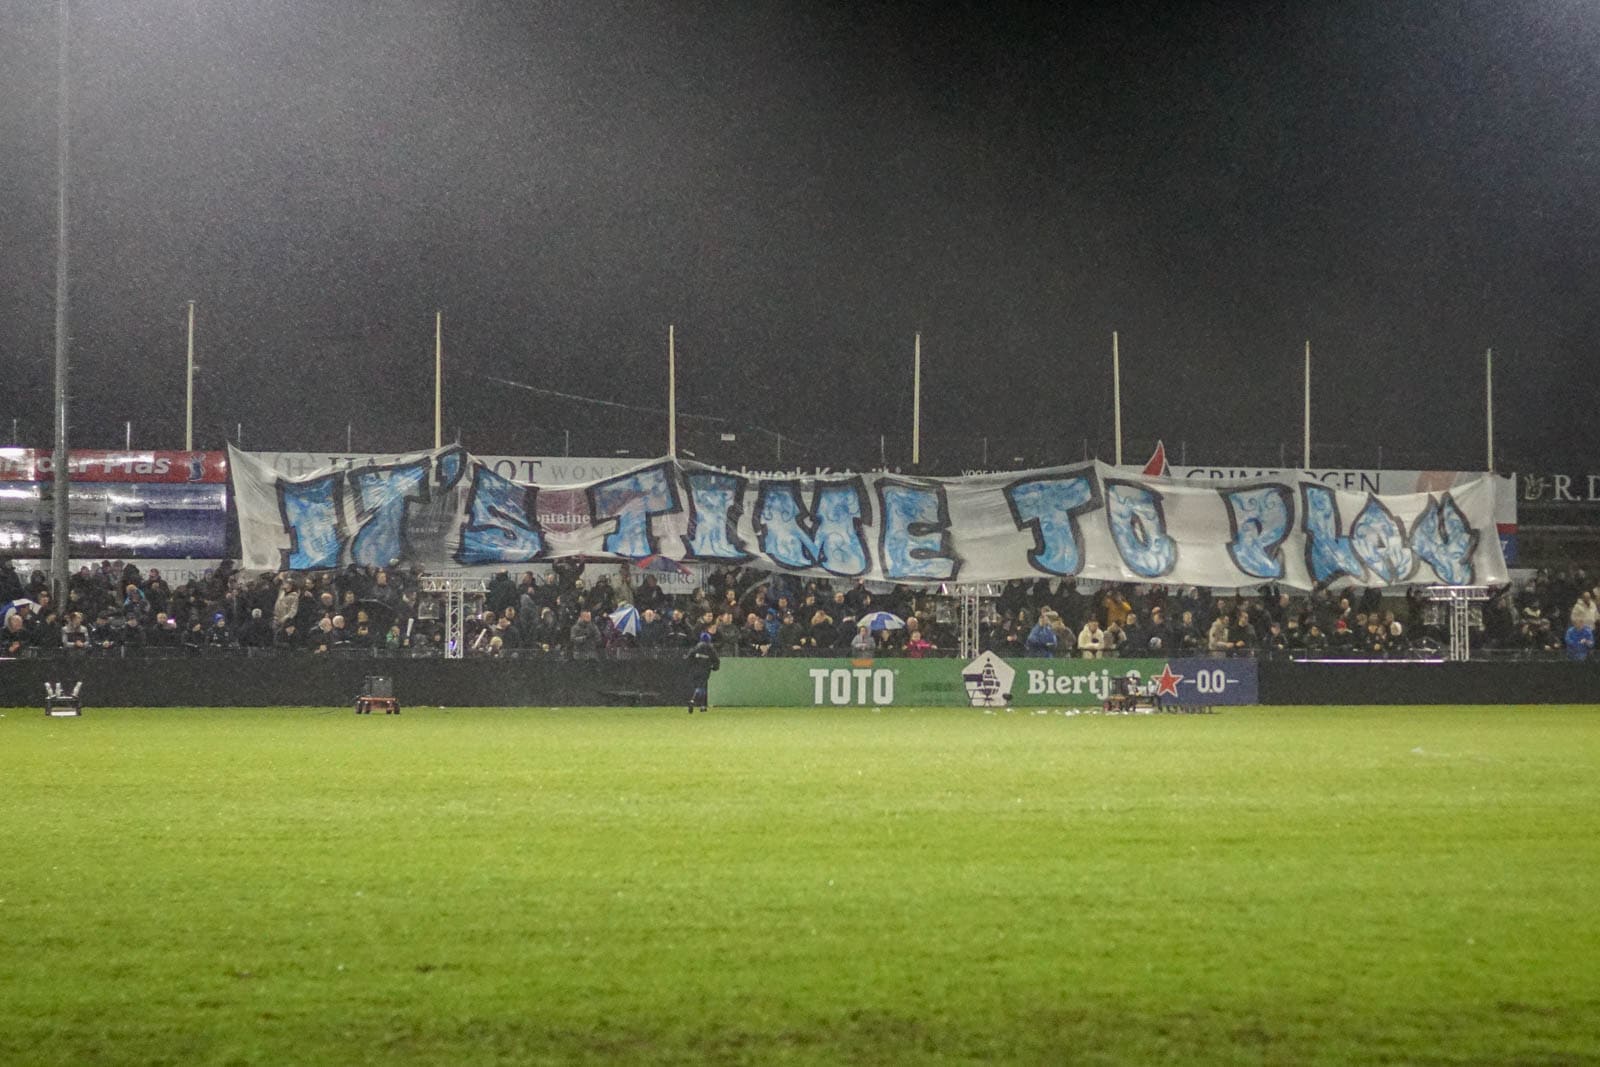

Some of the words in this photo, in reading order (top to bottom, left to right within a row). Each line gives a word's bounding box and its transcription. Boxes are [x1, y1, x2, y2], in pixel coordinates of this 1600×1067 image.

[104, 450, 170, 474] Plas
[586, 461, 964, 582] TIME
[1002, 464, 1178, 578] TO
[1216, 477, 1480, 590] PLAY
[809, 668, 894, 704] TOTO
[1027, 669, 1141, 700] Biertj
